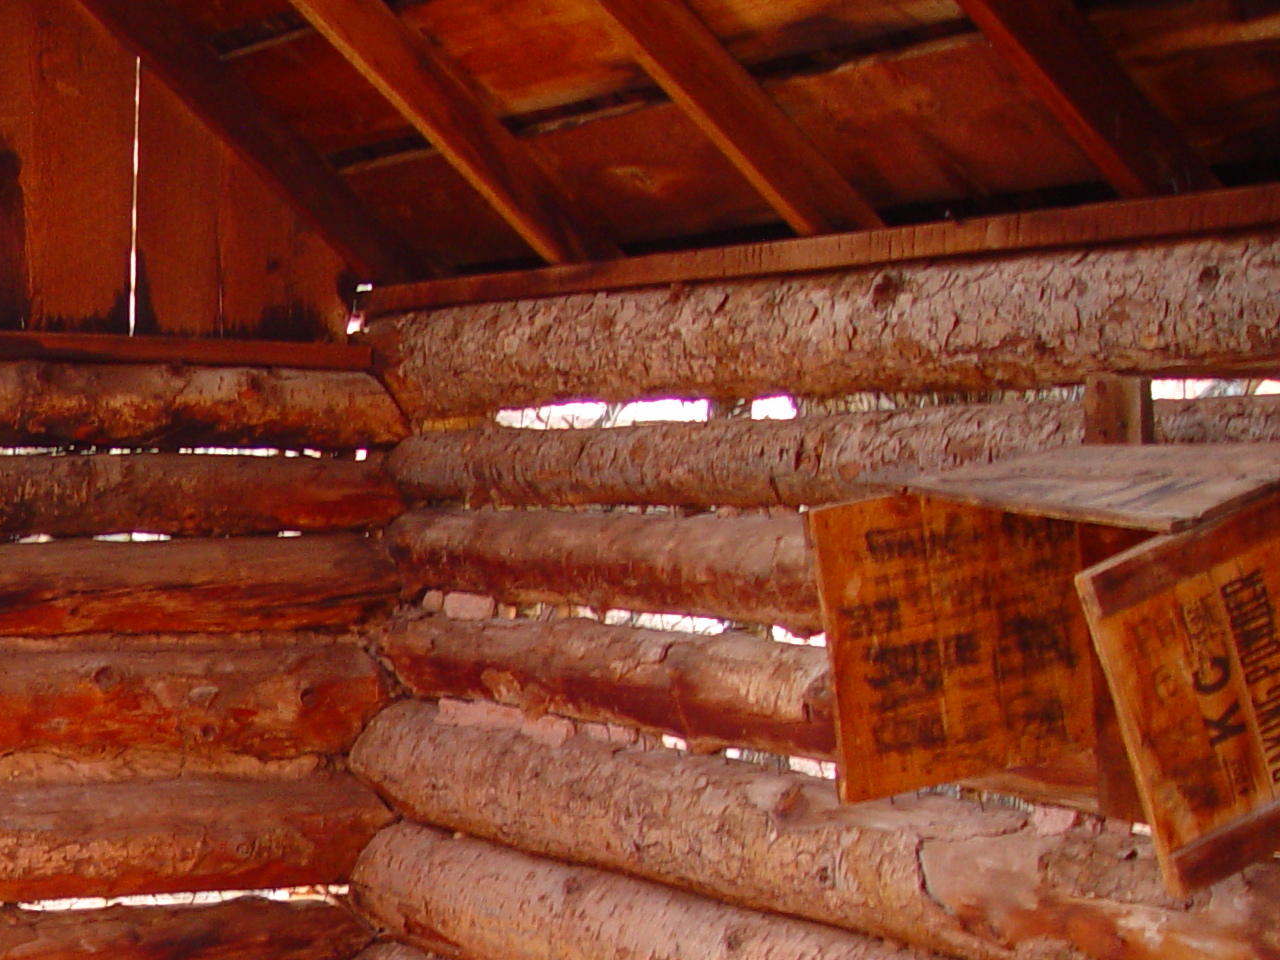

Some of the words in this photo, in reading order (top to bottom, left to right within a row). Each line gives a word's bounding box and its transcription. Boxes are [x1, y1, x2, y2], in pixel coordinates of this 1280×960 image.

[1221, 568, 1280, 685] POWDER
[1192, 656, 1231, 695] C
[1203, 702, 1248, 748] K
